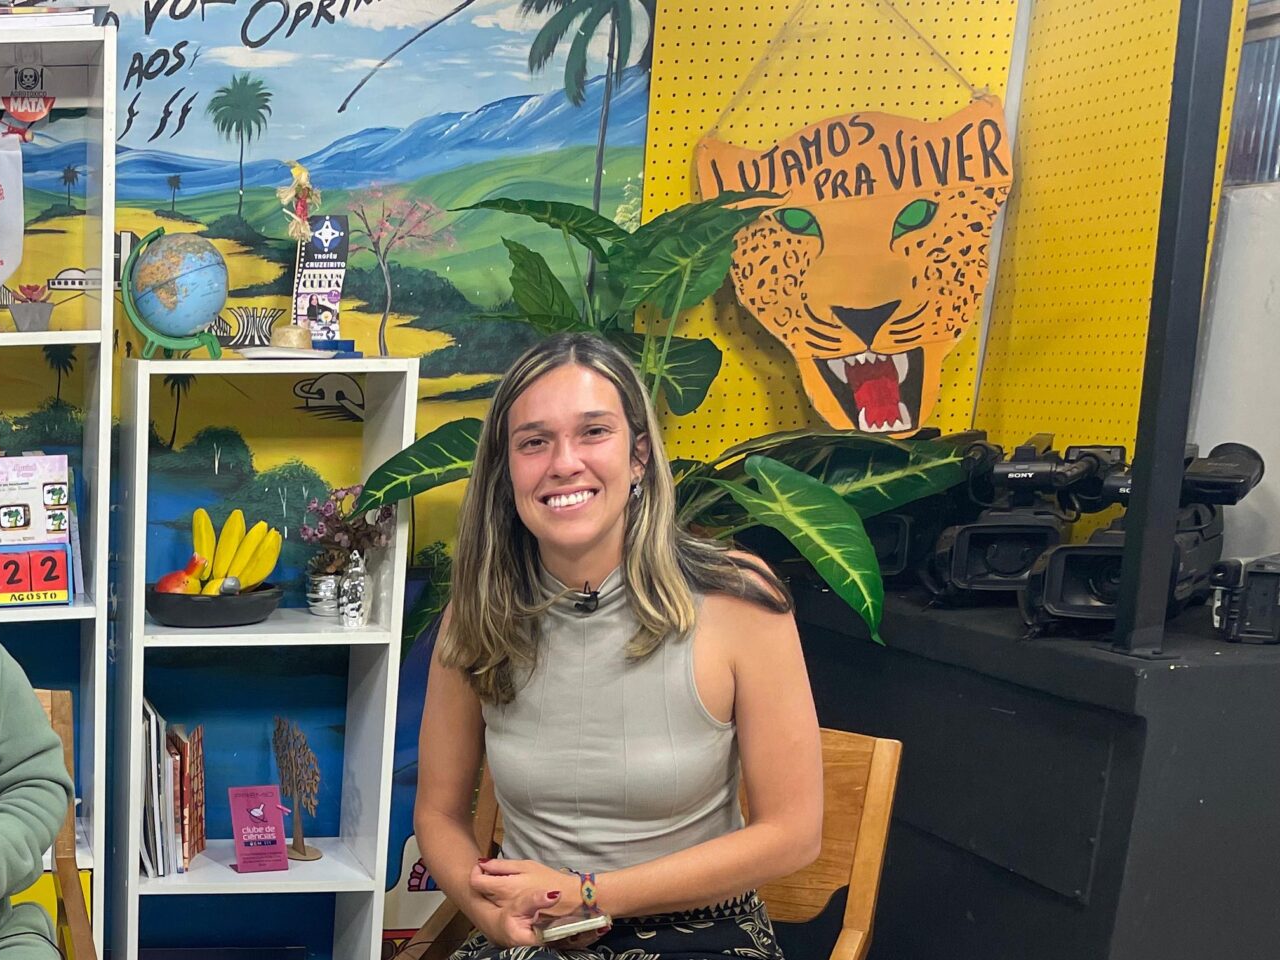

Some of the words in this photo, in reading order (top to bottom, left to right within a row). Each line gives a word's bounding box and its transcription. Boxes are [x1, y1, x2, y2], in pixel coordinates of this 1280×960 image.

[123, 40, 189, 91] AOS
[10, 97, 46, 112] MATA
[710, 114, 875, 193] LUTAMOS
[814, 162, 877, 202] PRA
[3, 559, 23, 585] 2
[40, 556, 60, 582] 2
[9, 592, 57, 602] AGOSTO
[241, 826, 264, 834] clube
[265, 825, 276, 833] de
